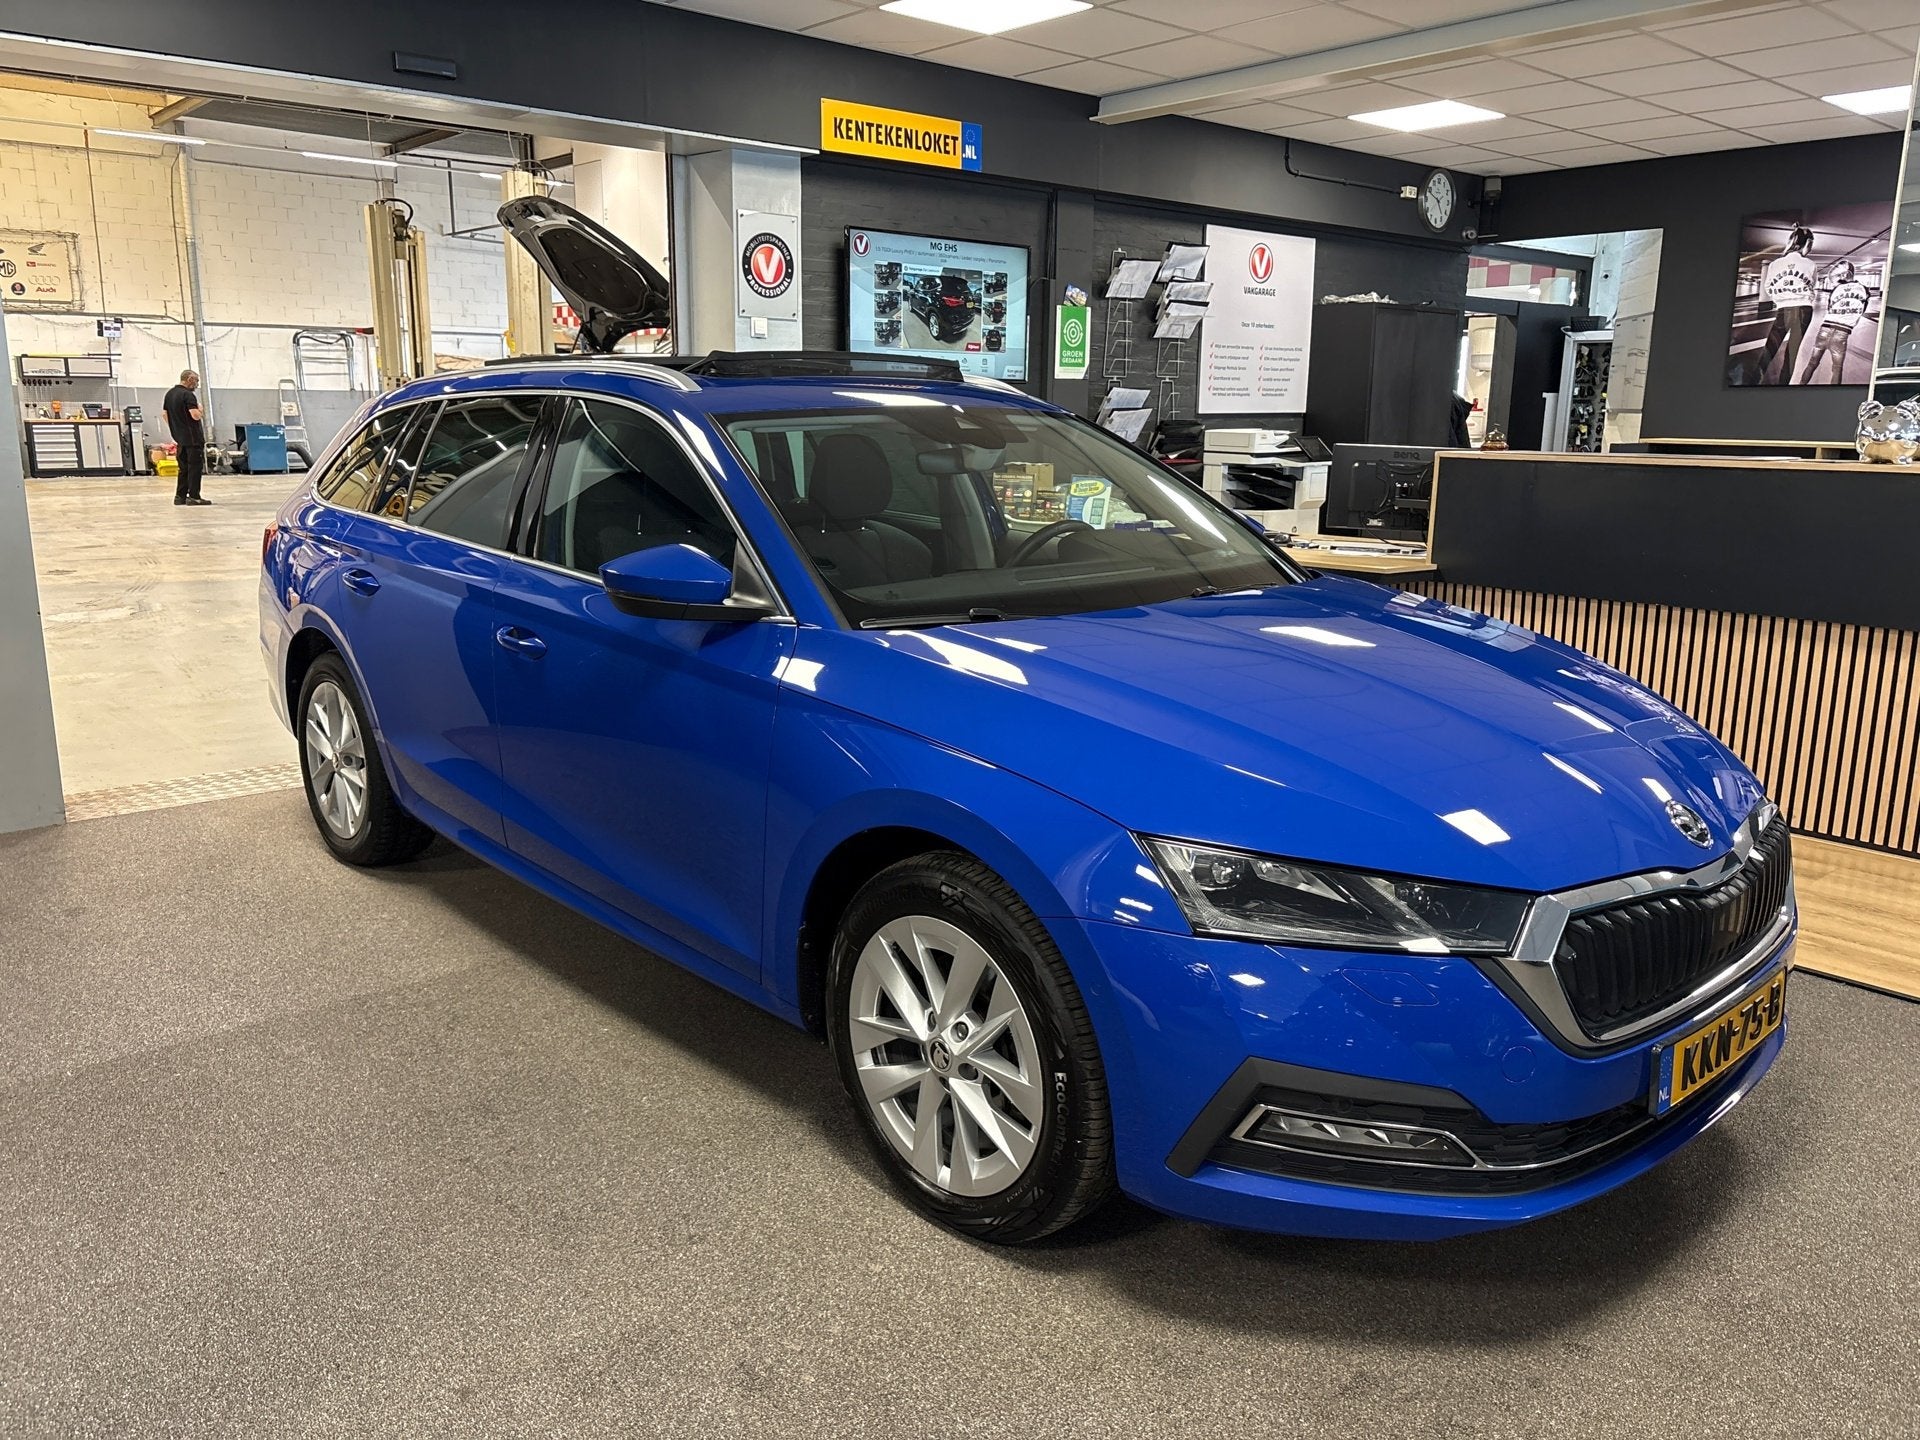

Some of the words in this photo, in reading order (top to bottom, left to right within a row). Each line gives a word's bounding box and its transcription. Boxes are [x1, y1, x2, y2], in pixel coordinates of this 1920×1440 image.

[833, 116, 959, 156] KENTEKENLOKET
[745, 235, 791, 261] MOBILITEITSPARTNER
[929, 241, 943, 251] MG
[944, 243, 958, 253] EHS
[746, 274, 791, 297] PROFESSIONAL
[1243, 286, 1276, 297] VAKGARAGE
[1062, 350, 1084, 358] GROEN
[1680, 982, 1781, 1091] KKN-75-B
[1658, 1086, 1670, 1103] NL
